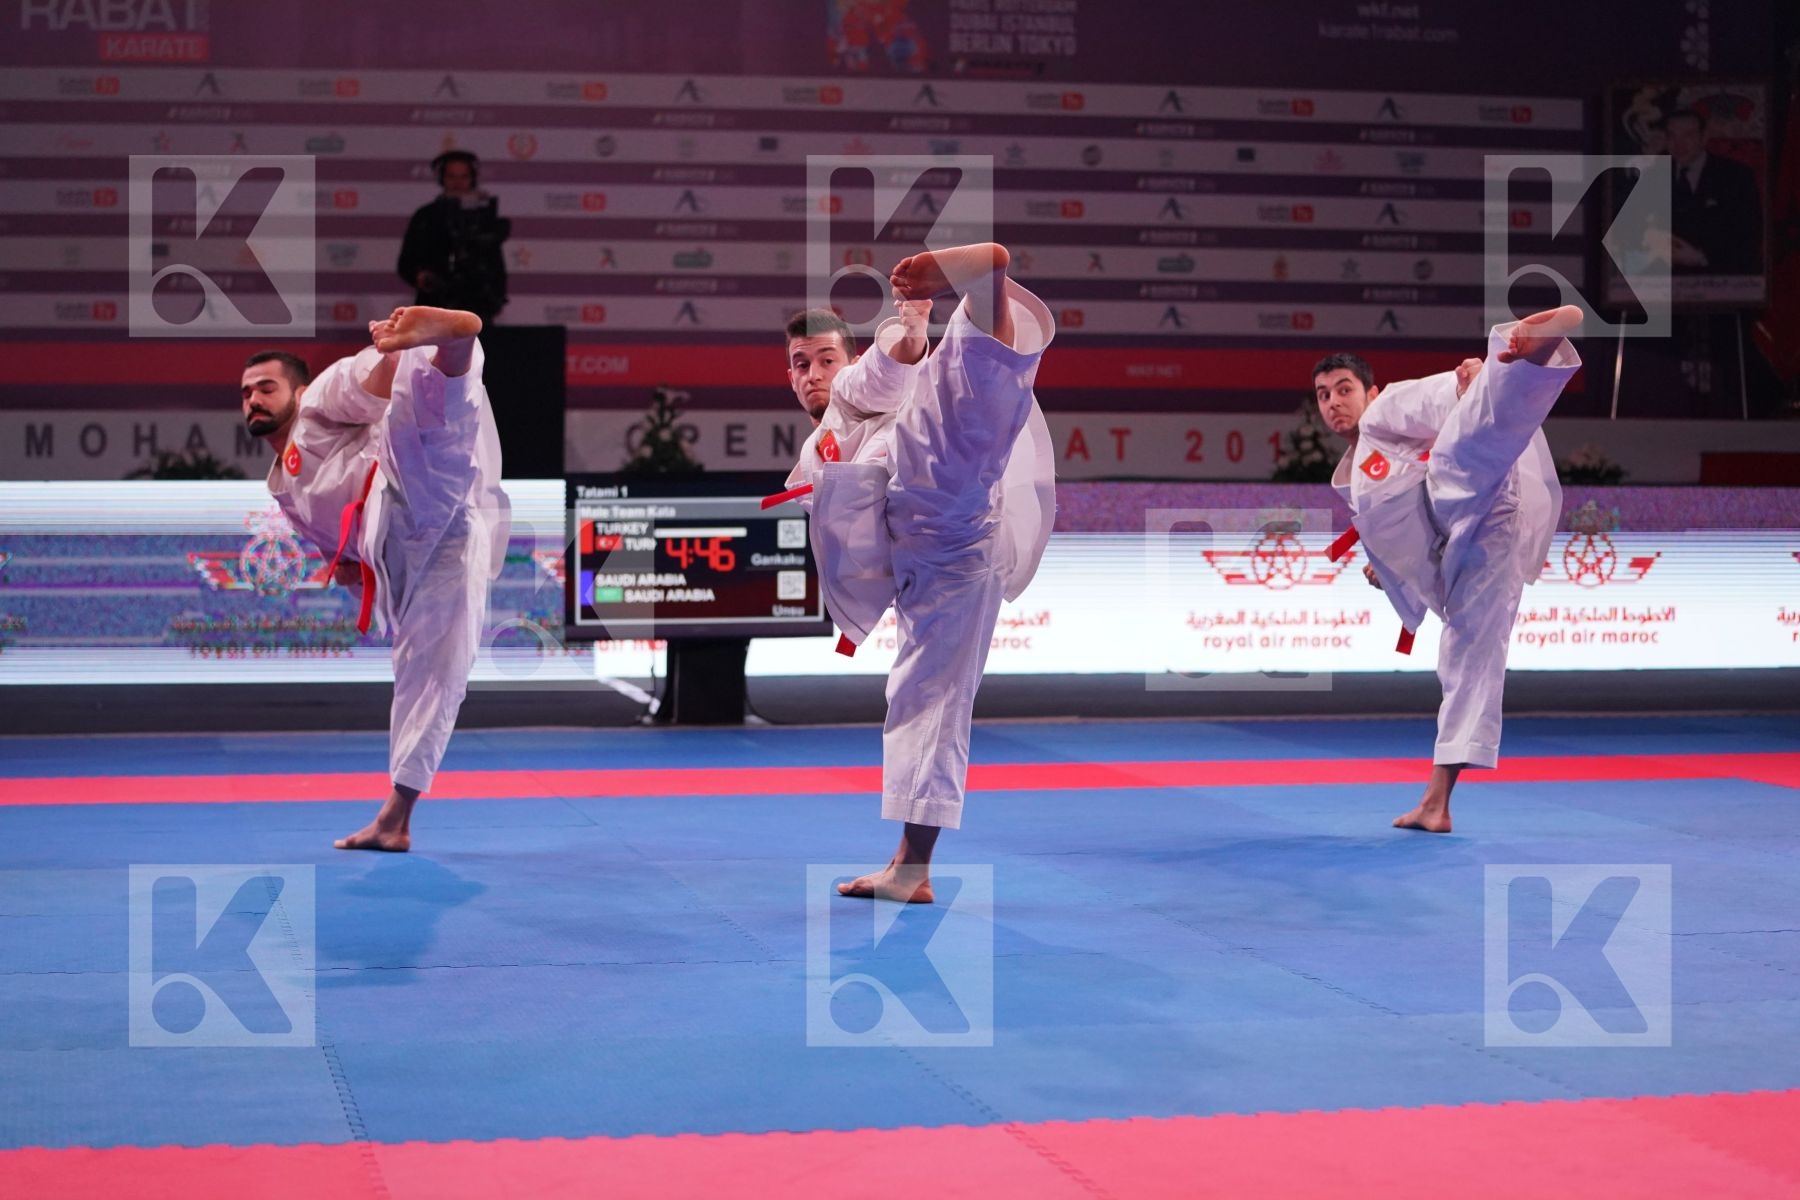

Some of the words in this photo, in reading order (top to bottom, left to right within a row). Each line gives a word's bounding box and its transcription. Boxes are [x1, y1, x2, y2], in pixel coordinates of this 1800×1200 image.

[106, 36, 200, 57] KARATE
[1018, 35, 1077, 56] TOKYO
[1184, 430, 1283, 463] 201
[576, 486, 617, 498] Tatami
[613, 506, 646, 518] Team
[647, 506, 676, 518] Kata
[596, 522, 648, 535] TURKEY
[665, 536, 736, 572] 4:46
[751, 554, 805, 566] Gankaku
[596, 573, 636, 587] SAUDI
[637, 573, 687, 586] ARABIA
[624, 589, 664, 603] SAUDI
[666, 588, 715, 602] ARABIA
[990, 635, 1032, 649] aroc
[1203, 632, 1253, 651] royal
[1260, 632, 1285, 648] air
[1291, 635, 1352, 648] maroc
[1517, 630, 1565, 648] royal
[1571, 629, 1596, 643] air
[1602, 630, 1659, 644] maroc
